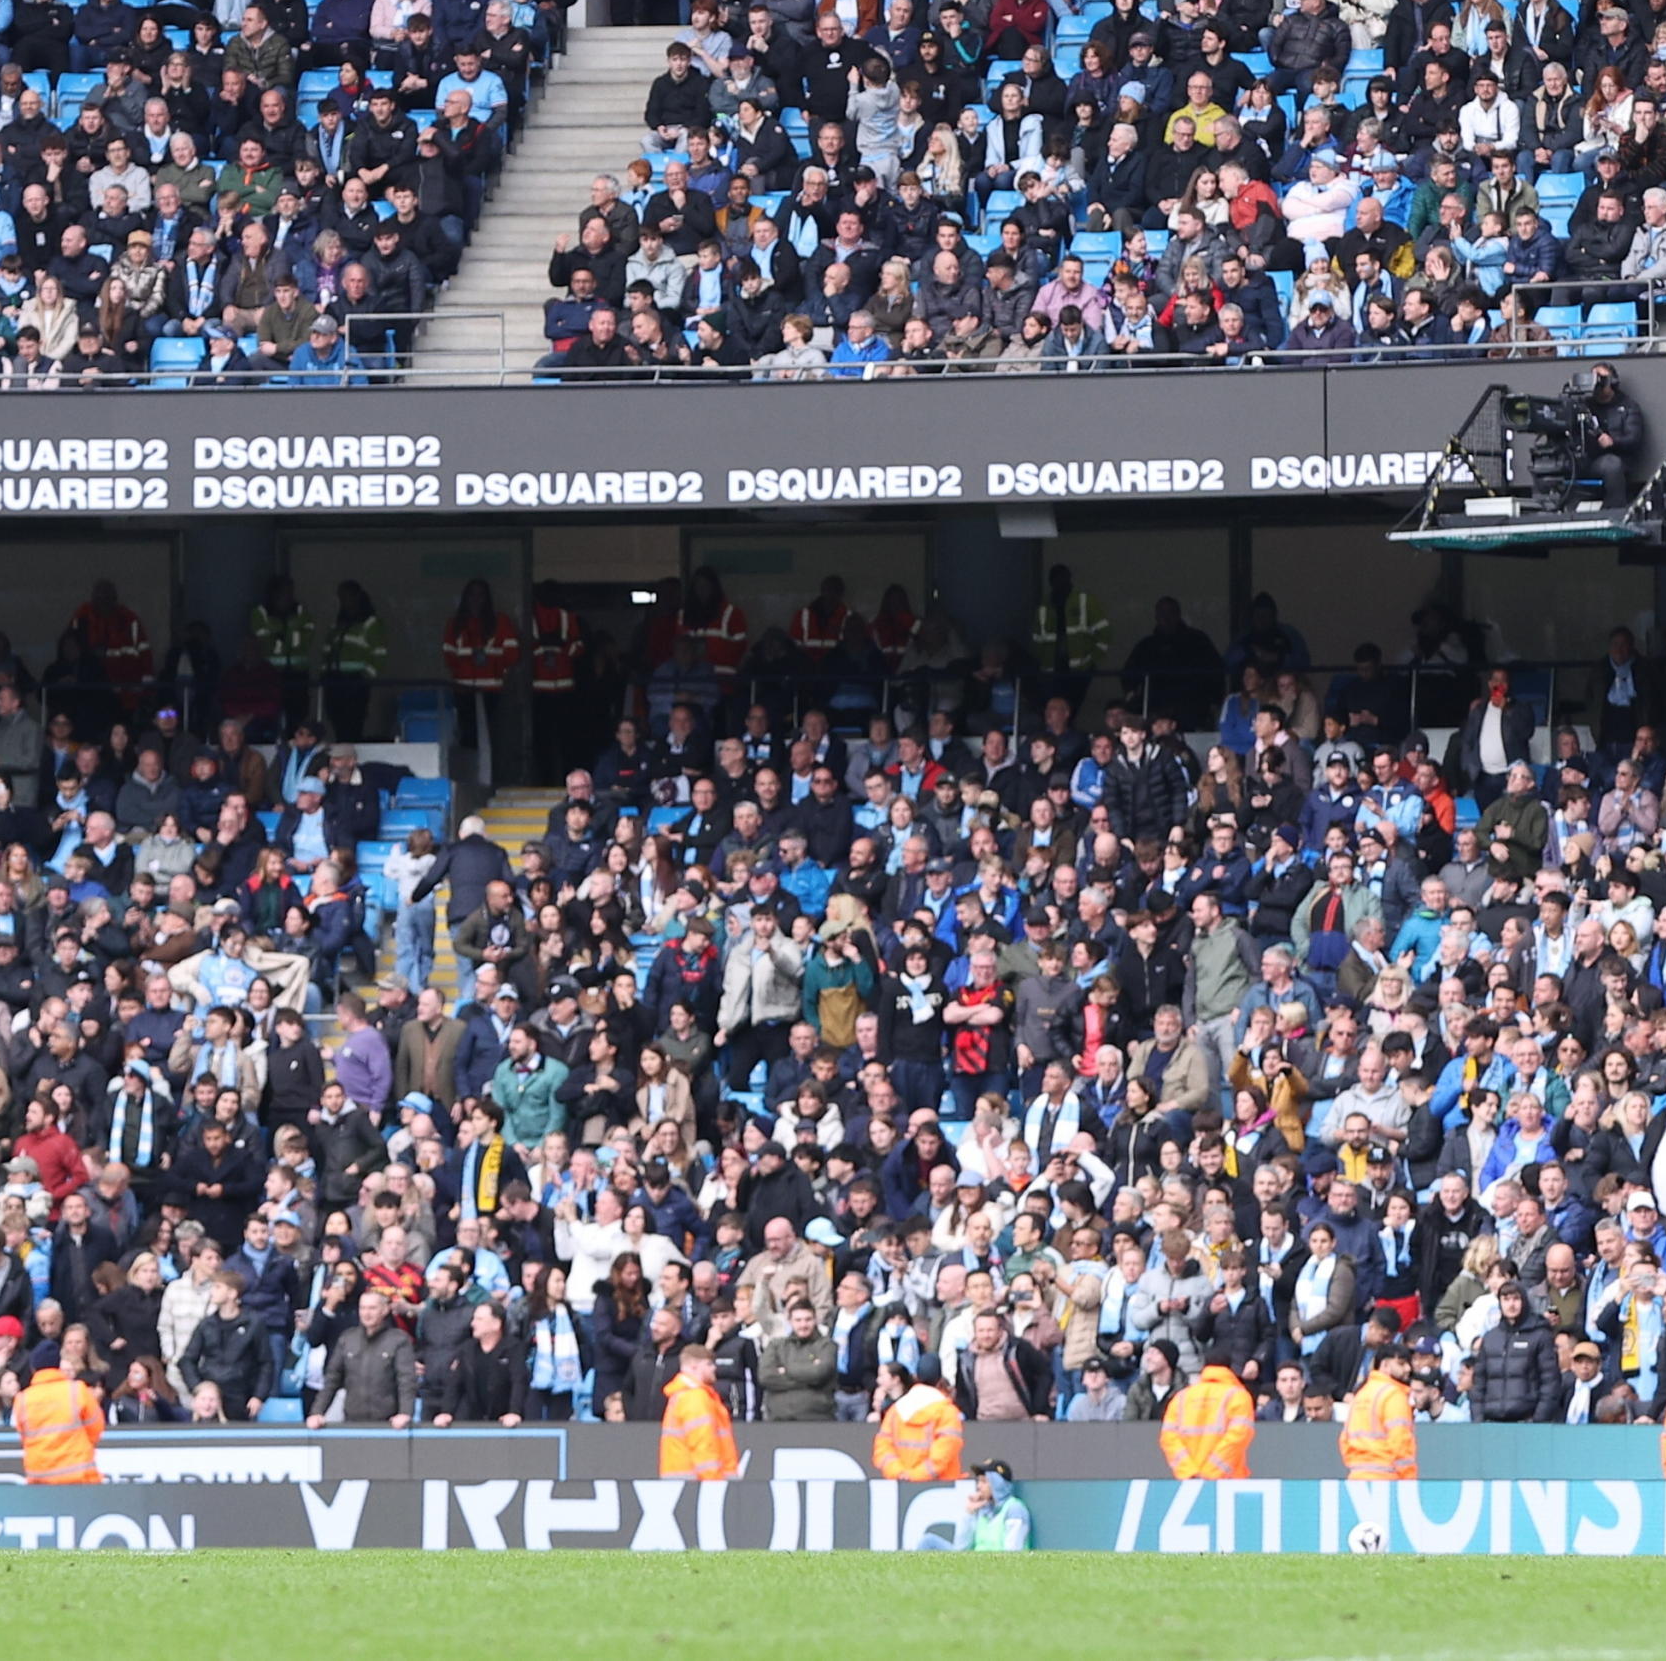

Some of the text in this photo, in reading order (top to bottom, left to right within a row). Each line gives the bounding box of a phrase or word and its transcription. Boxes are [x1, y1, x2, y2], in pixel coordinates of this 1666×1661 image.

[194, 436, 440, 470] DSQUARED2
[194, 475, 439, 509] DSQUARED2
[456, 472, 702, 506] DSQUARED2
[728, 466, 961, 501] DSQUARED2
[988, 460, 1224, 496] DSQUARED2
